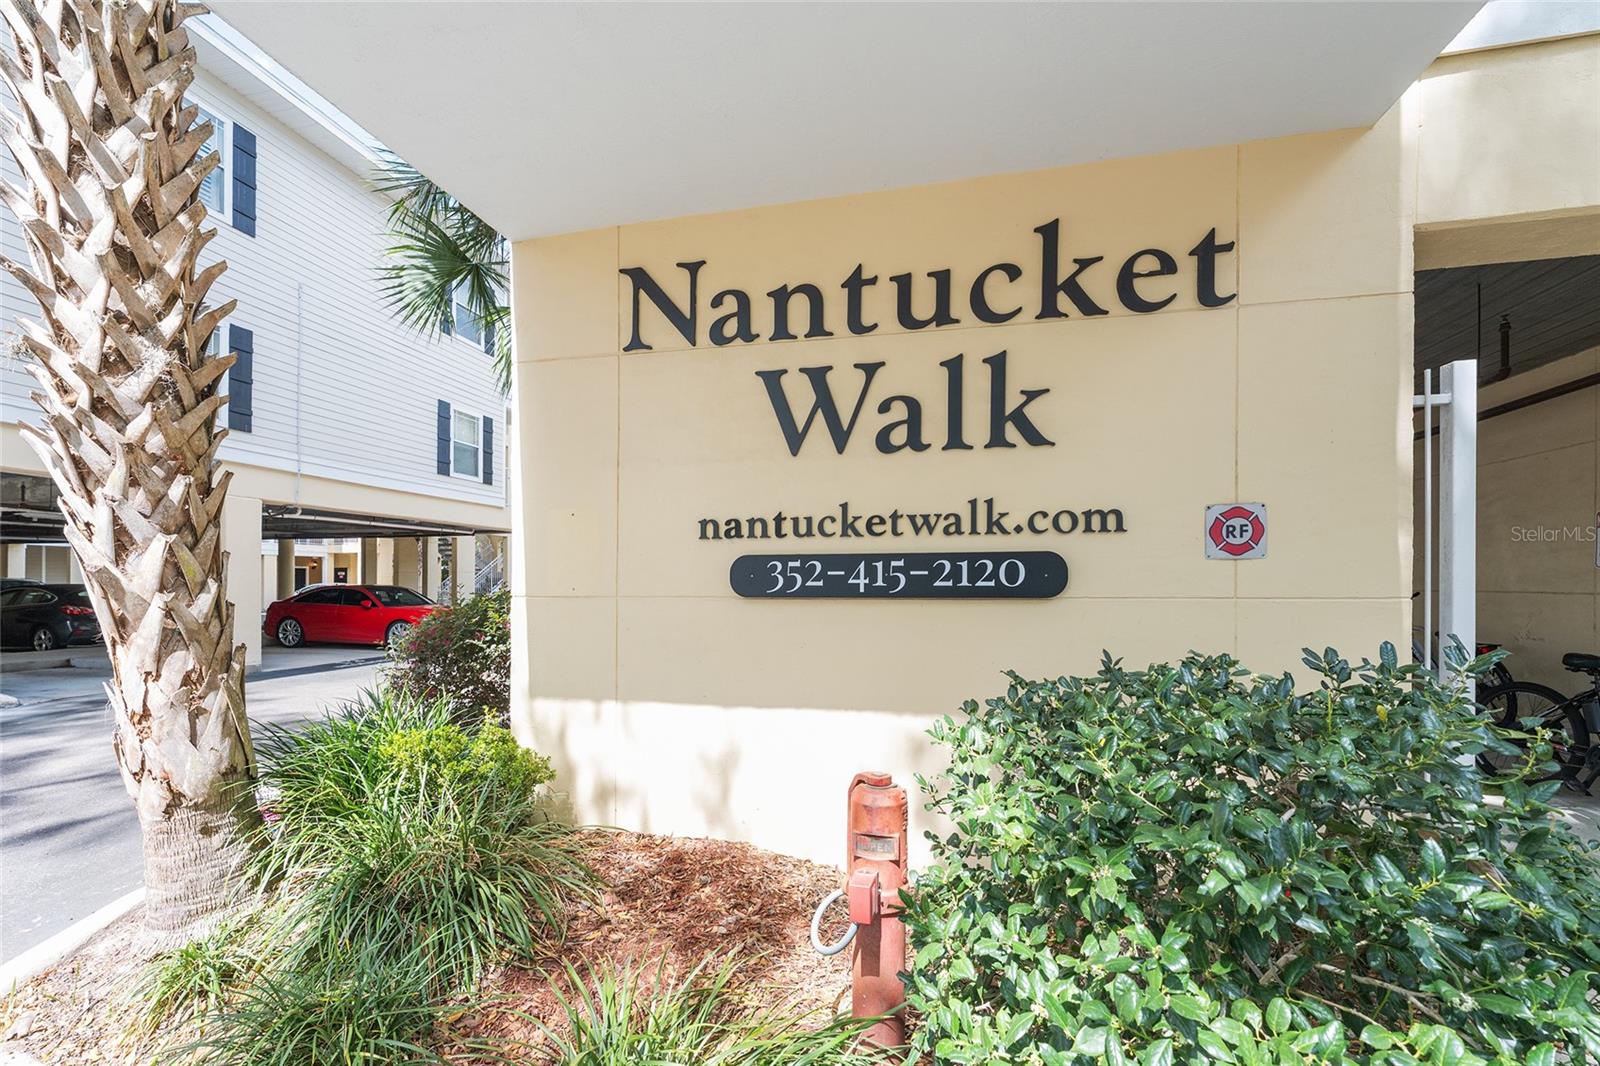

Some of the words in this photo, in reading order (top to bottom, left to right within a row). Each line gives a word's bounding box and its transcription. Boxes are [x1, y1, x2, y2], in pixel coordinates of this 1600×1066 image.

[619, 218, 1237, 352] Nantucket
[754, 350, 1055, 457] Walk
[698, 498, 1128, 540] nantucketwalk.com
[1225, 523, 1249, 539] RF
[766, 558, 1026, 594] 352-415-2120
